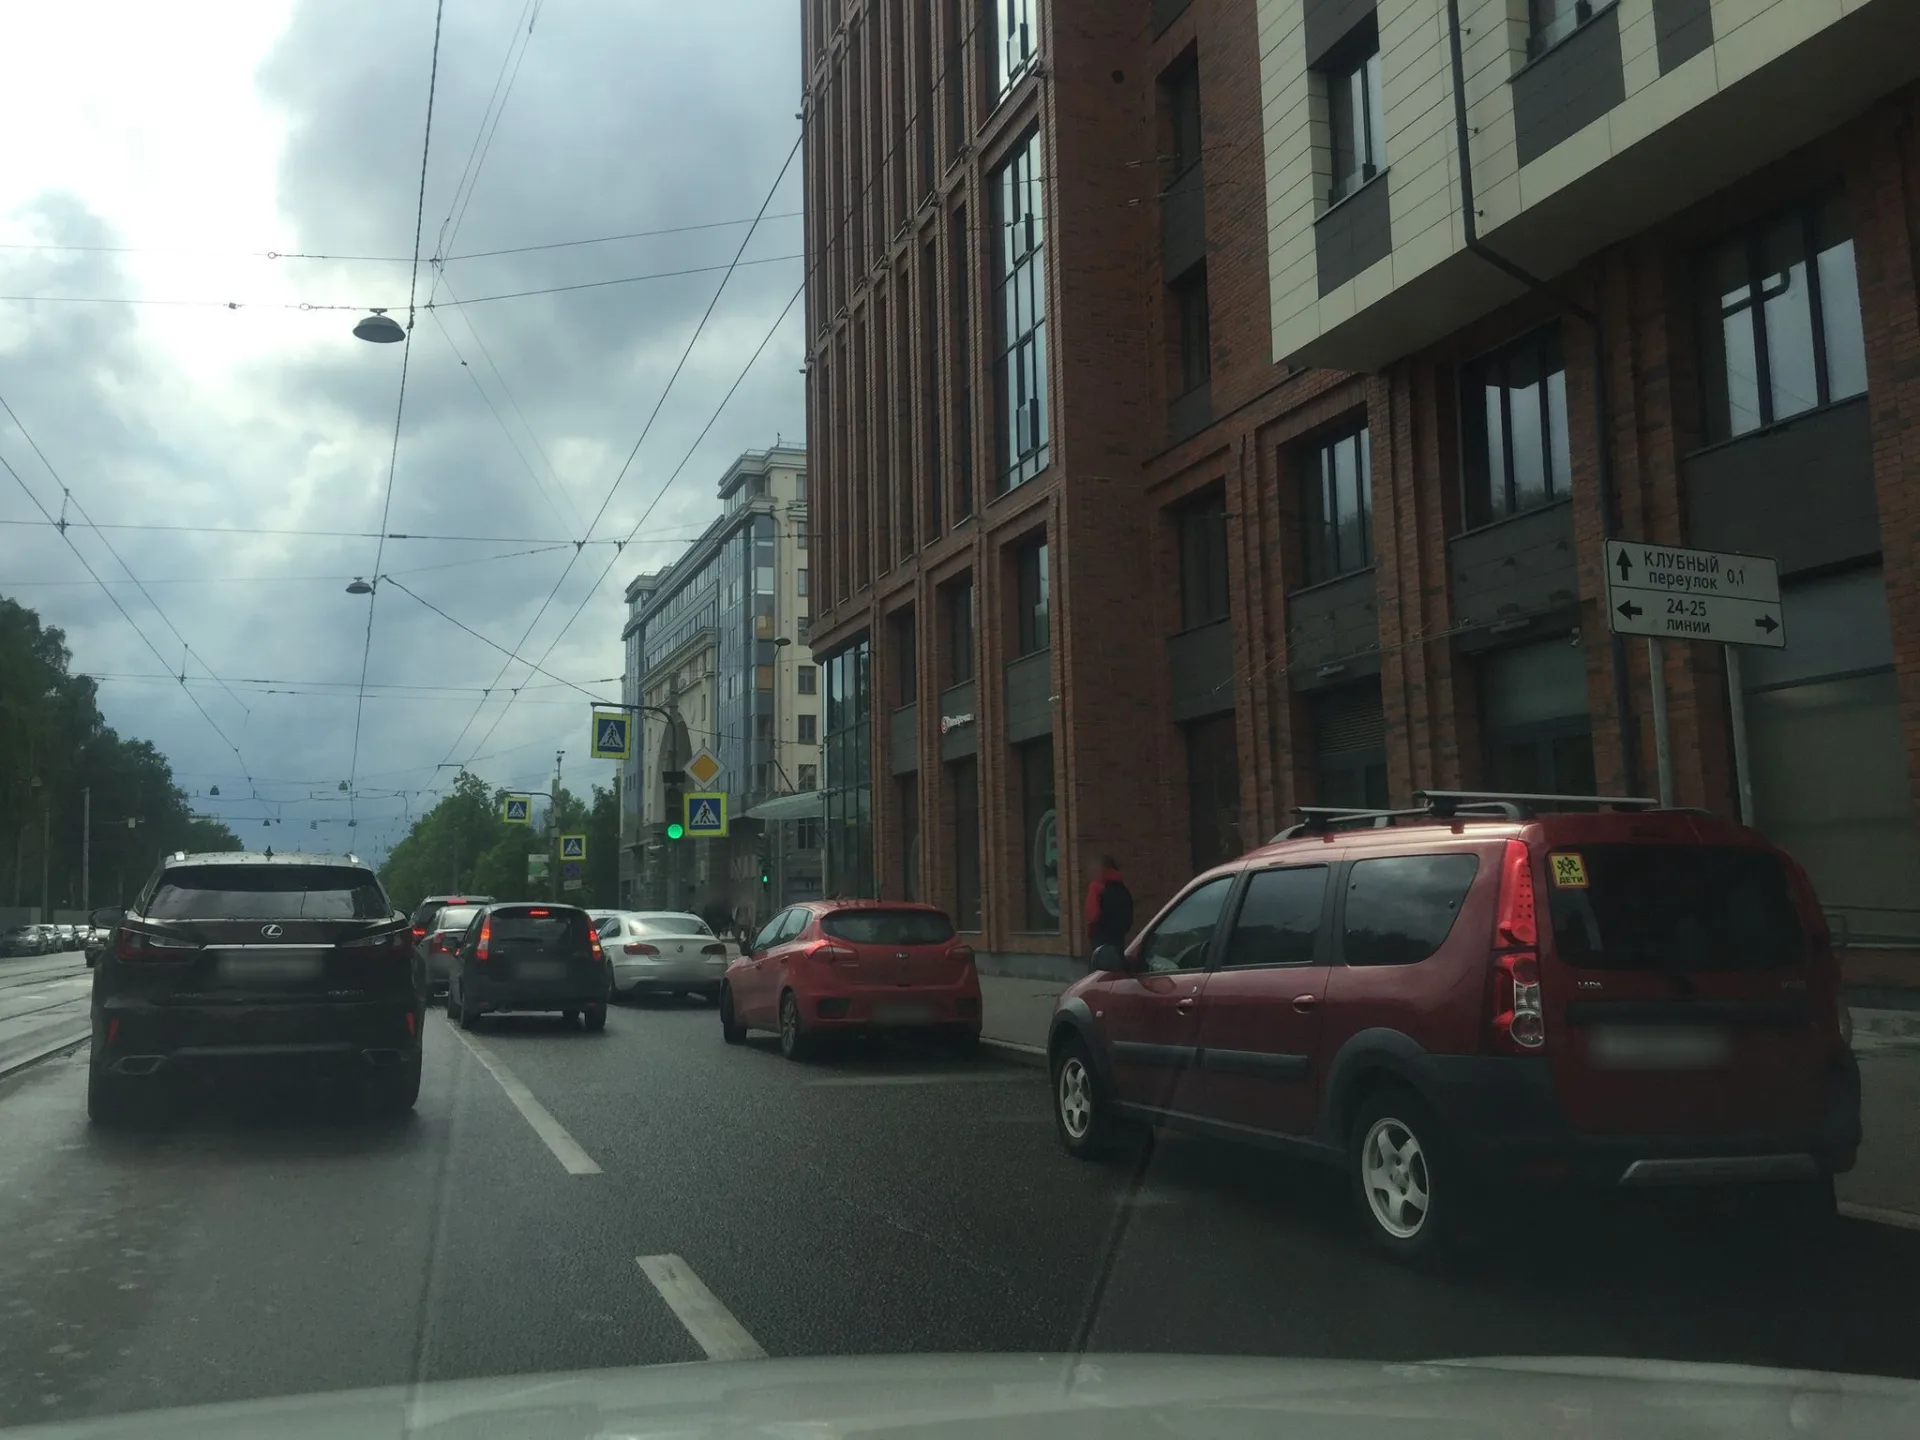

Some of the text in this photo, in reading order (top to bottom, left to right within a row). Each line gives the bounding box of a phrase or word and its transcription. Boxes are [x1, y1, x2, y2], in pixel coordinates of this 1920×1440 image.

[1644, 551, 1719, 573] КЛУБНЫЙ
[1649, 571, 1718, 590] переулок
[1726, 569, 1745, 586] 0,1
[1666, 598, 1707, 616] 24-25
[1559, 876, 1585, 884] ДЕТИ
